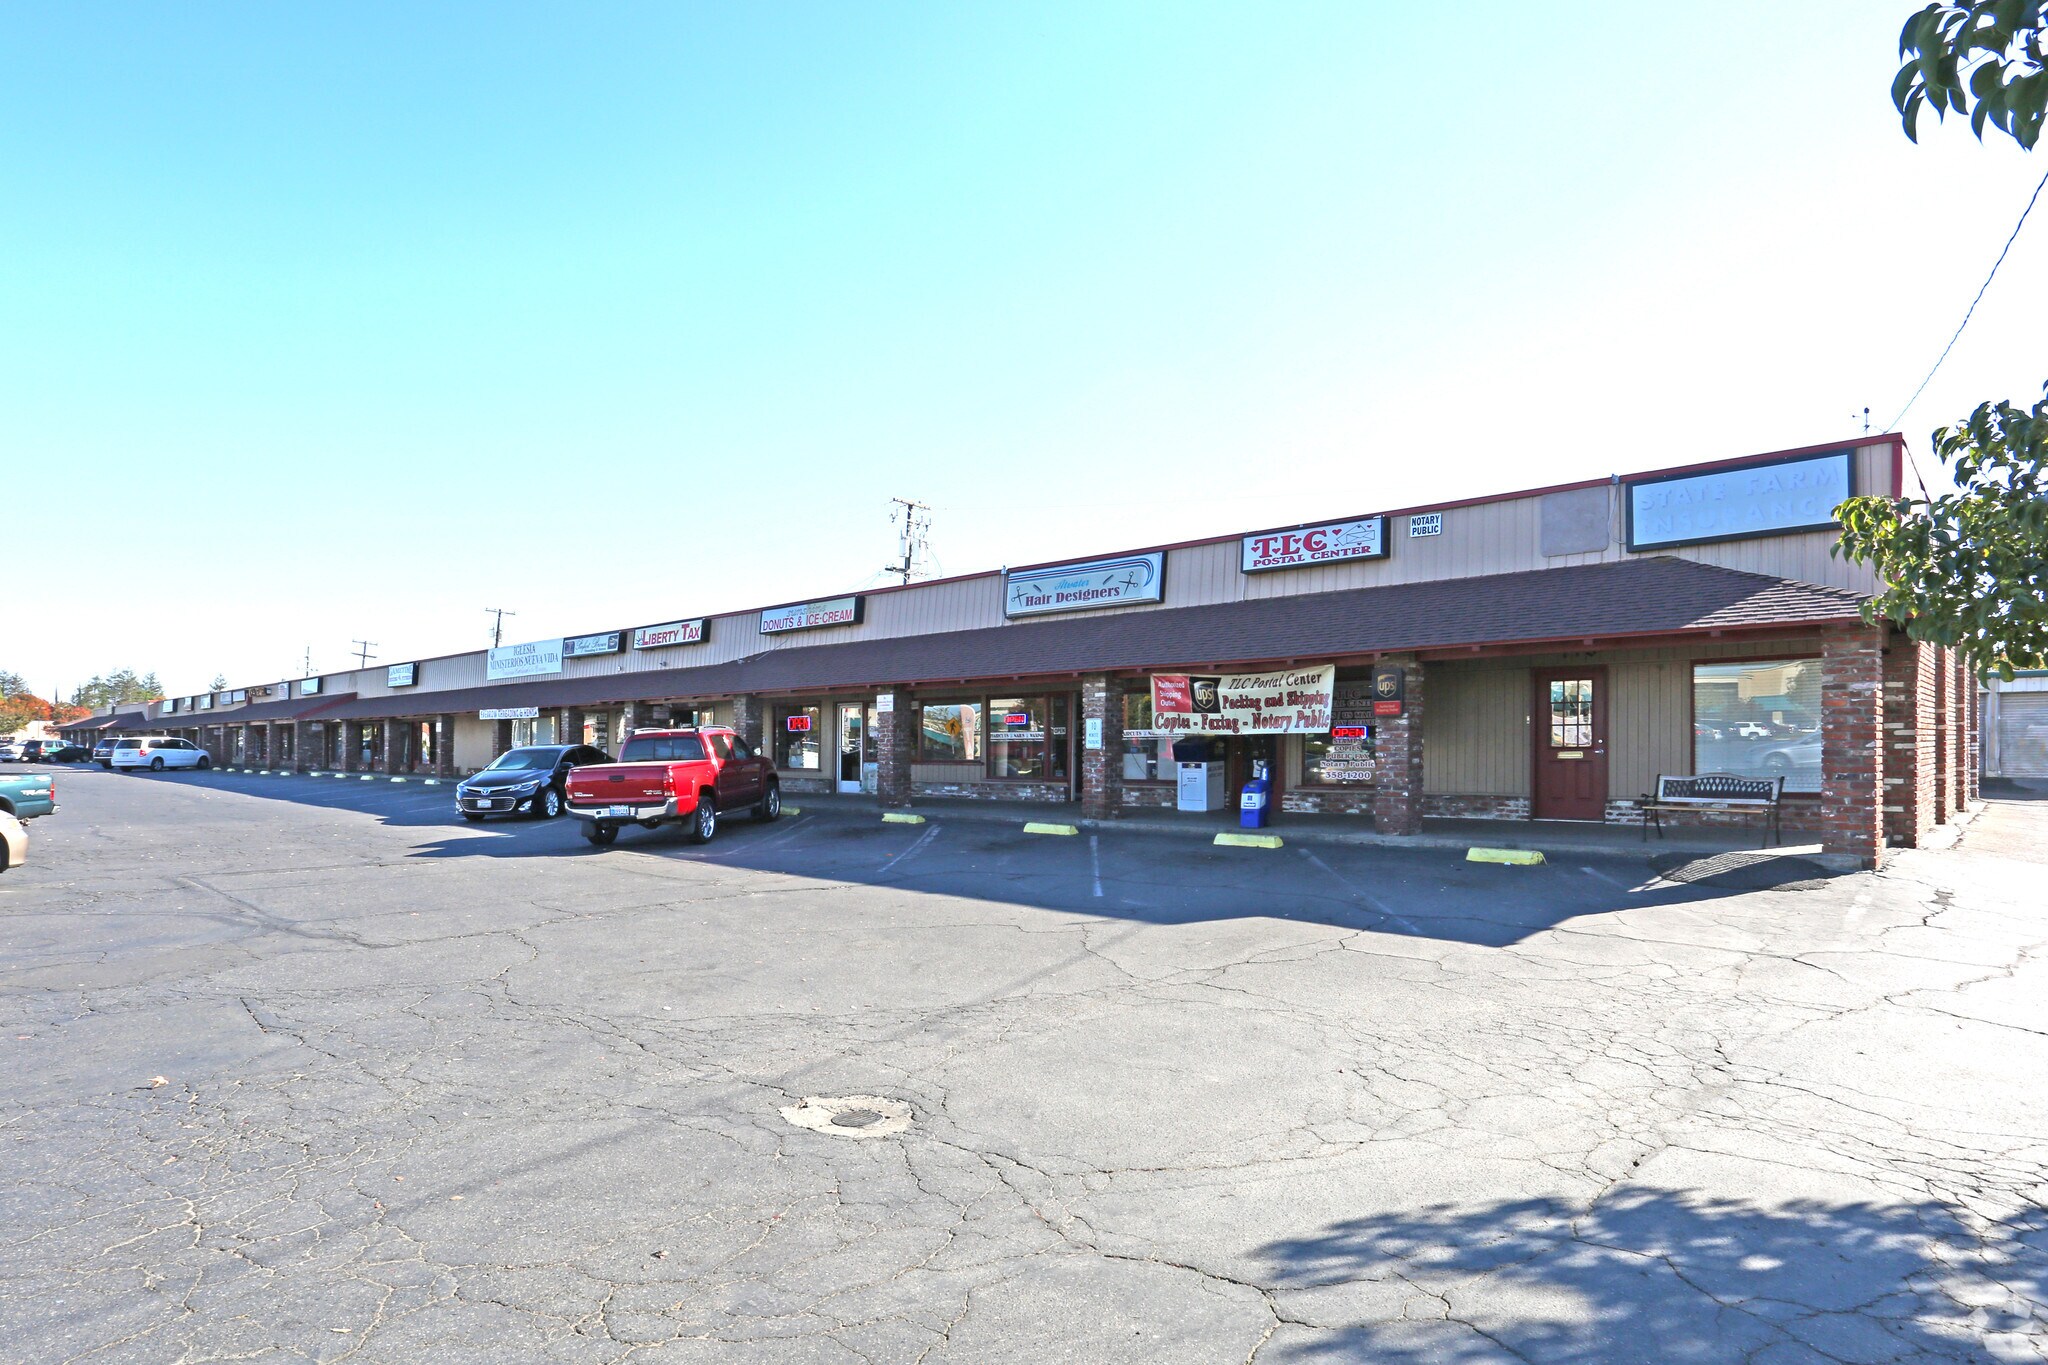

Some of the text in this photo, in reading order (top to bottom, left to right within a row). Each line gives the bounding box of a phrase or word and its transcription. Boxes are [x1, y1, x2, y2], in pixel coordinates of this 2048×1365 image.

[1640, 464, 1840, 511] STATE FARM
[1411, 514, 1440, 526] NOTARY
[1411, 524, 1440, 535] PUBLIC
[1254, 529, 1328, 559] TLC
[1252, 545, 1372, 567] POSTAL CENTER
[1025, 586, 1120, 607] Hair Designers
[763, 616, 795, 631] DONUTS
[796, 615, 803, 626] &
[513, 643, 536, 656] IGLESIA
[490, 652, 559, 670] MINISTERIOS NUEVA VIDA
[1228, 673, 1322, 690] TLC Postal Center
[1379, 682, 1396, 694] ups
[1159, 690, 1182, 699] Shipping
[1196, 688, 1213, 704] ups
[1222, 694, 1263, 711] Packing
[1264, 693, 1284, 707] and
[1287, 690, 1331, 709] Shipping
[789, 716, 809, 730] OPEN
[1004, 714, 1025, 724] OPEN
[1154, 713, 1190, 733] Copies
[1200, 713, 1240, 734] Faxing
[1251, 711, 1293, 733] Notary
[1294, 709, 1330, 730] Public
[1332, 728, 1365, 738] OPEN
[1350, 760, 1376, 768] Public
[1325, 771, 1371, 779] 358-1200
